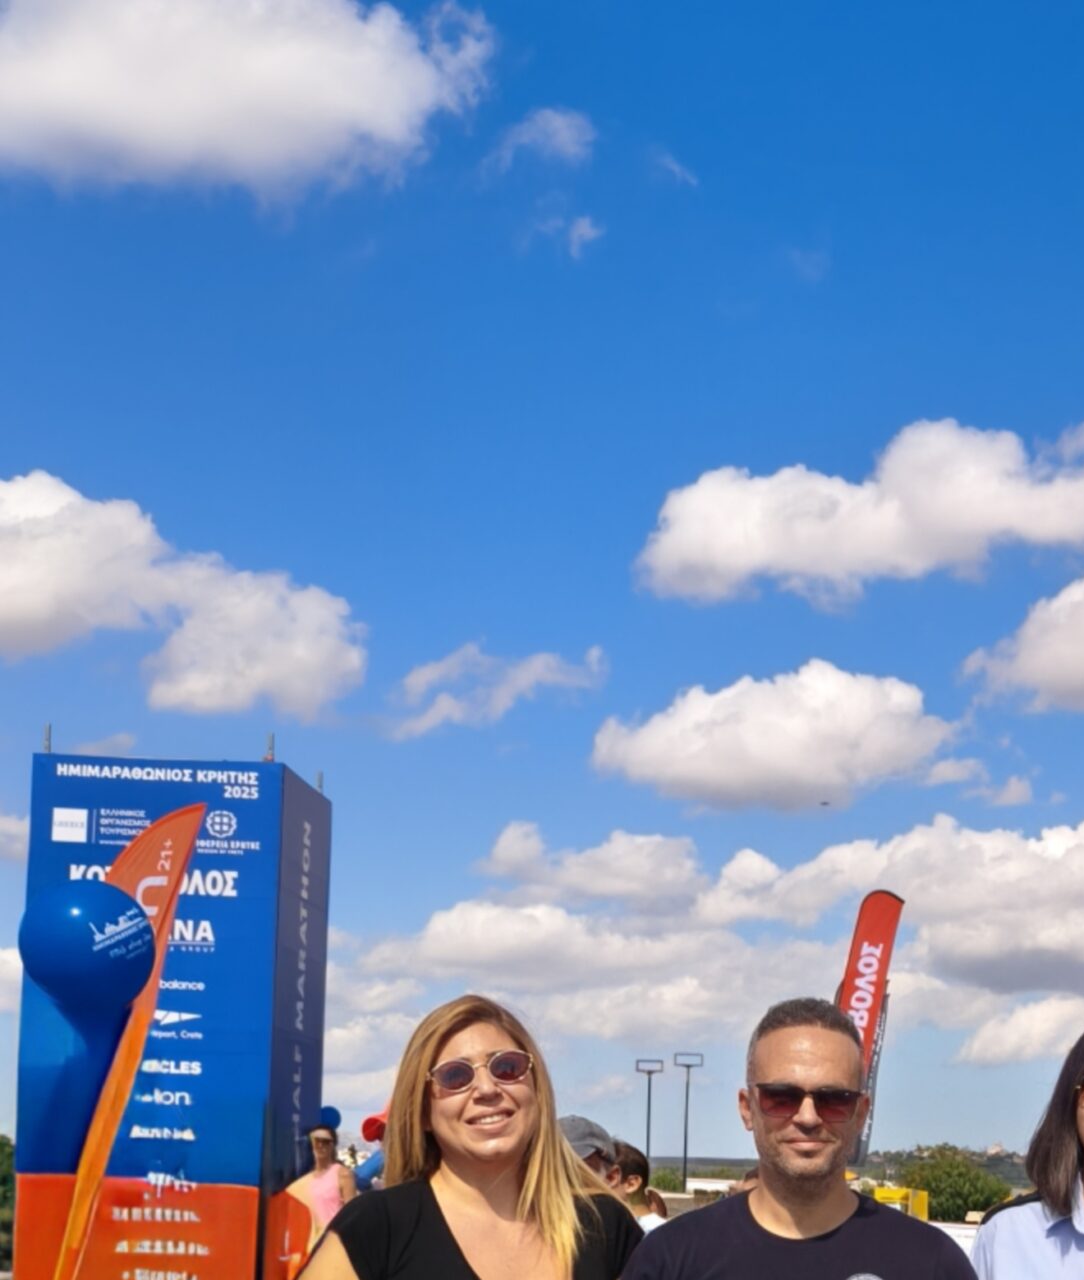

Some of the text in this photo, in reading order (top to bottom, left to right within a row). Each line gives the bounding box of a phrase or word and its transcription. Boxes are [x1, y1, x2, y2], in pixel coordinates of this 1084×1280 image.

[56, 763, 260, 785] ΗΜΙΜΑΡΑΘΩΝΙΟΣ ΚΡΗΤΗΣ
[223, 785, 260, 799] 2025
[295, 820, 311, 1031] MARATHON
[848, 942, 884, 1041] ΒΟΛΟΣ
